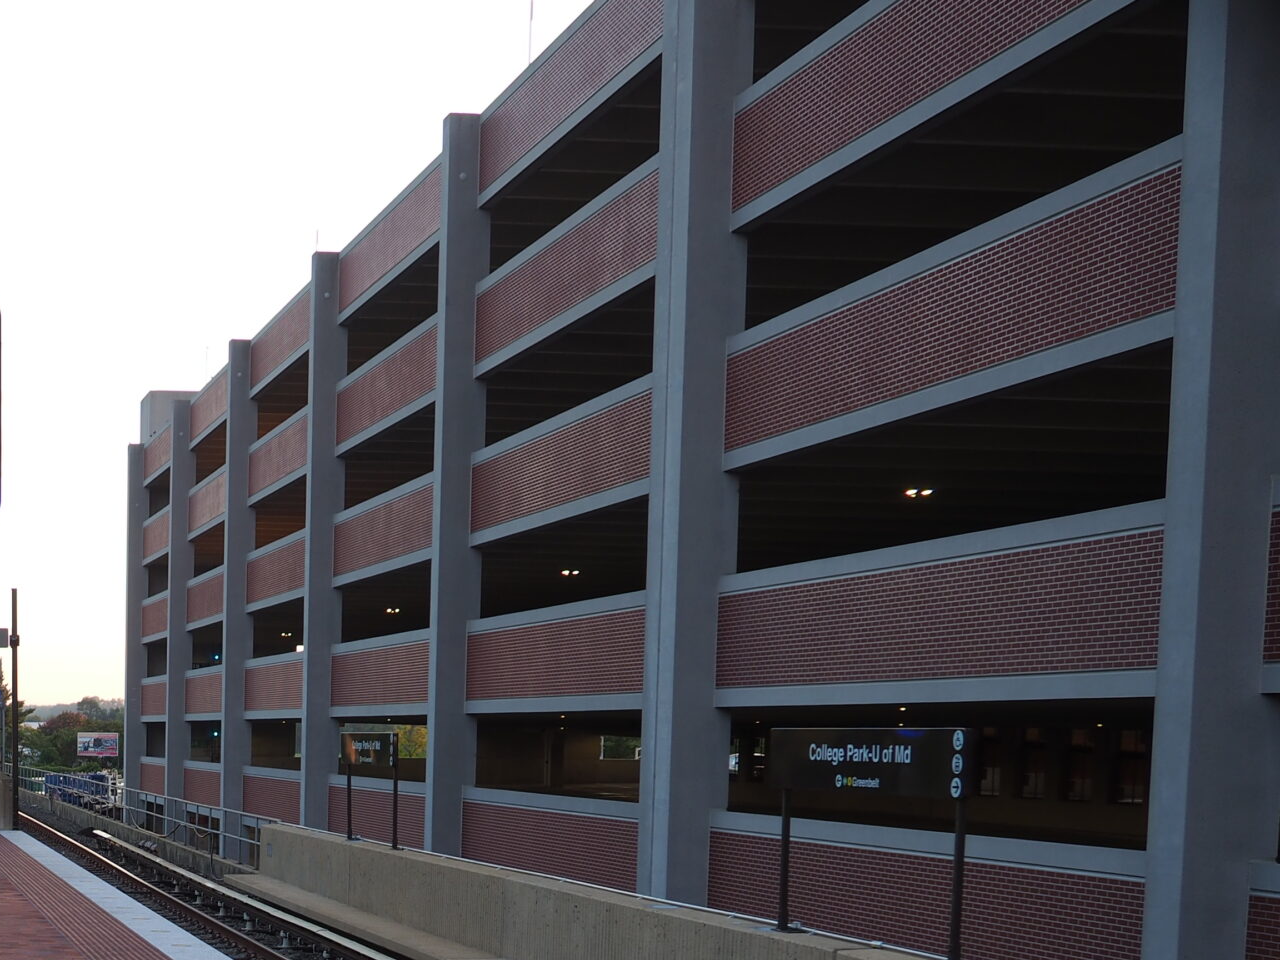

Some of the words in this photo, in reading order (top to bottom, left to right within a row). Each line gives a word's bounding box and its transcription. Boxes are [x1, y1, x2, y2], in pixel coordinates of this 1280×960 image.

[809, 743, 845, 766] College
[847, 743, 880, 763] Park-U
[882, 745, 893, 763] of
[894, 745, 912, 764] Md
[852, 776, 880, 788] Greenbelt
